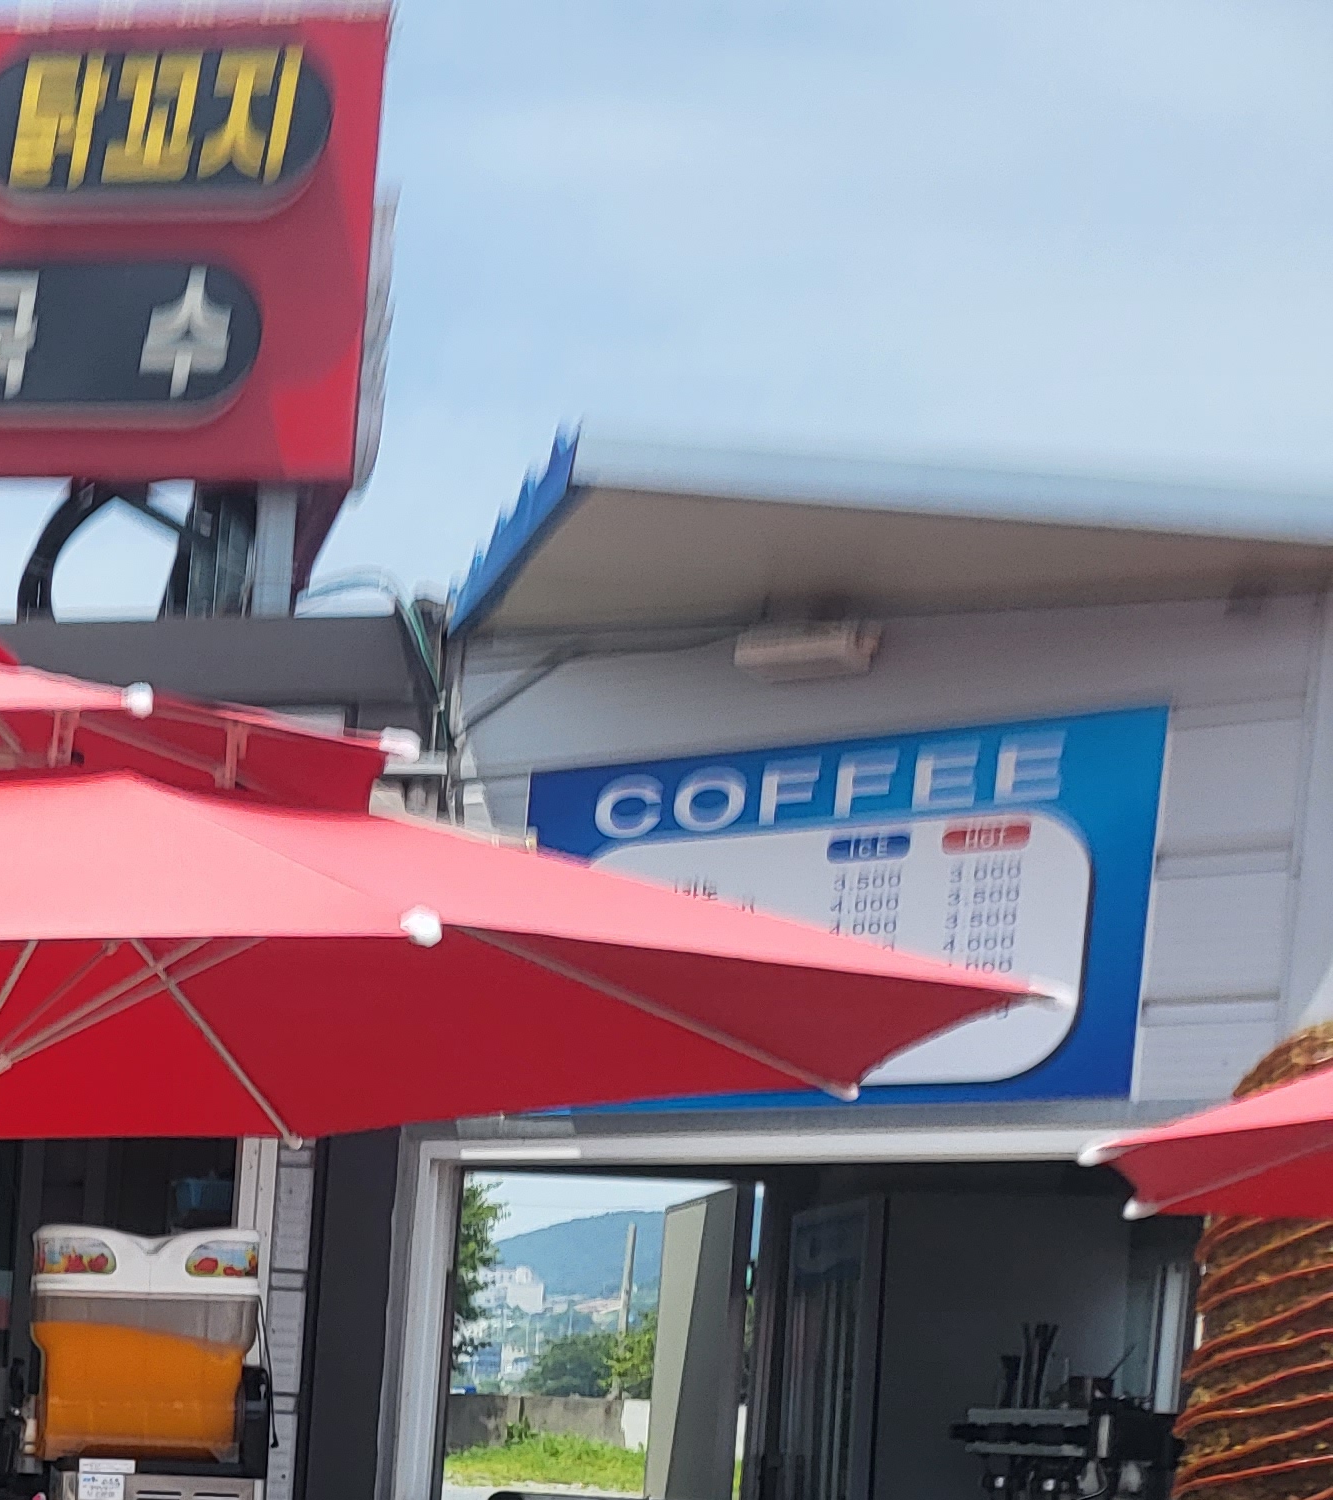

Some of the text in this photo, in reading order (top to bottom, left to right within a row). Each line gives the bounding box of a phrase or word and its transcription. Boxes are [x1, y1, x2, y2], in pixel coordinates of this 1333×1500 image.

[10, 46, 303, 190] 닭꼬치
[595, 731, 1066, 840] COFFEE
[848, 836, 889, 859] ICE
[964, 826, 1007, 849] HOT
